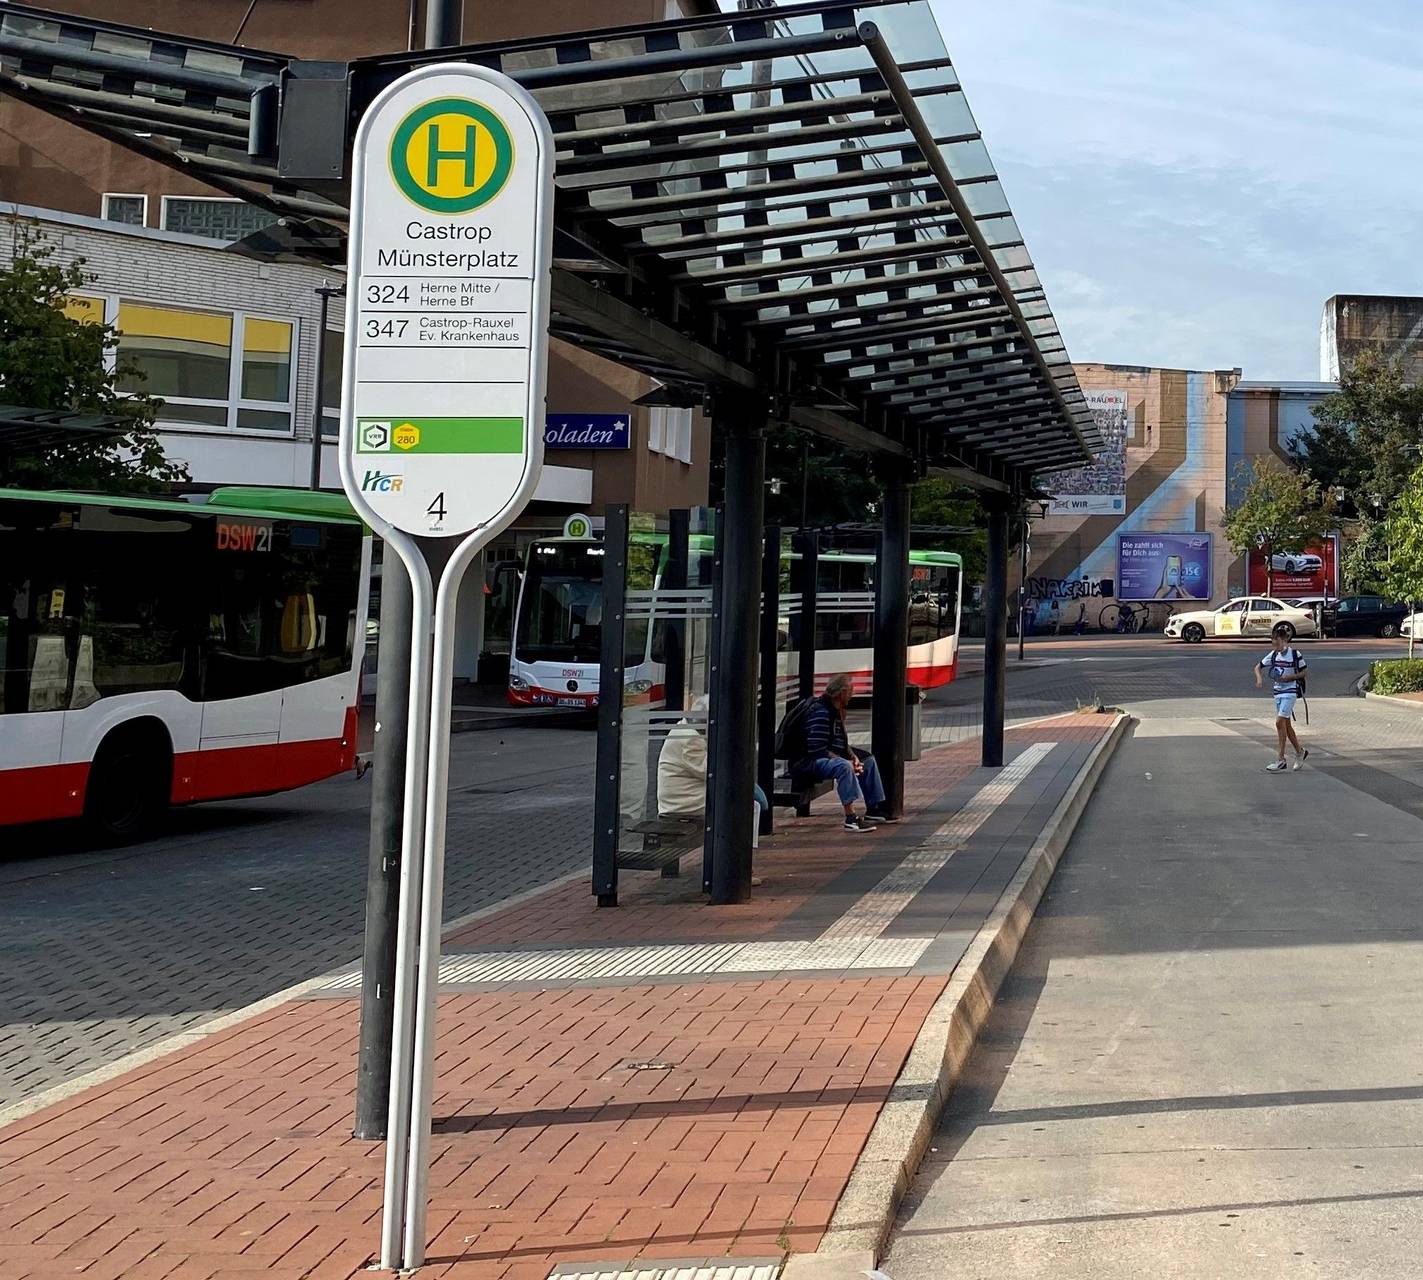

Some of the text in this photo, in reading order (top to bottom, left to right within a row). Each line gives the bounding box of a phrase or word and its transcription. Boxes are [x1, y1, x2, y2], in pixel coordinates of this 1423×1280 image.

[427, 124, 476, 188] H
[406, 221, 493, 244] Castrop
[377, 248, 519, 271] Münsterplatz
[367, 285, 410, 304] 324
[420, 282, 457, 293] Herne
[460, 283, 491, 294] Mitte
[420, 296, 474, 306] Herne Bf
[366, 317, 514, 338] 347 Castrop-Rauxel
[419, 331, 520, 342] Ev. Krankenhaus
[397, 435, 415, 444] 280
[545, 423, 614, 443] oladen
[361, 470, 404, 492] HCR
[427, 492, 447, 521] 4
[1071, 500, 1088, 508] WIR
[217, 523, 272, 552] DSW21
